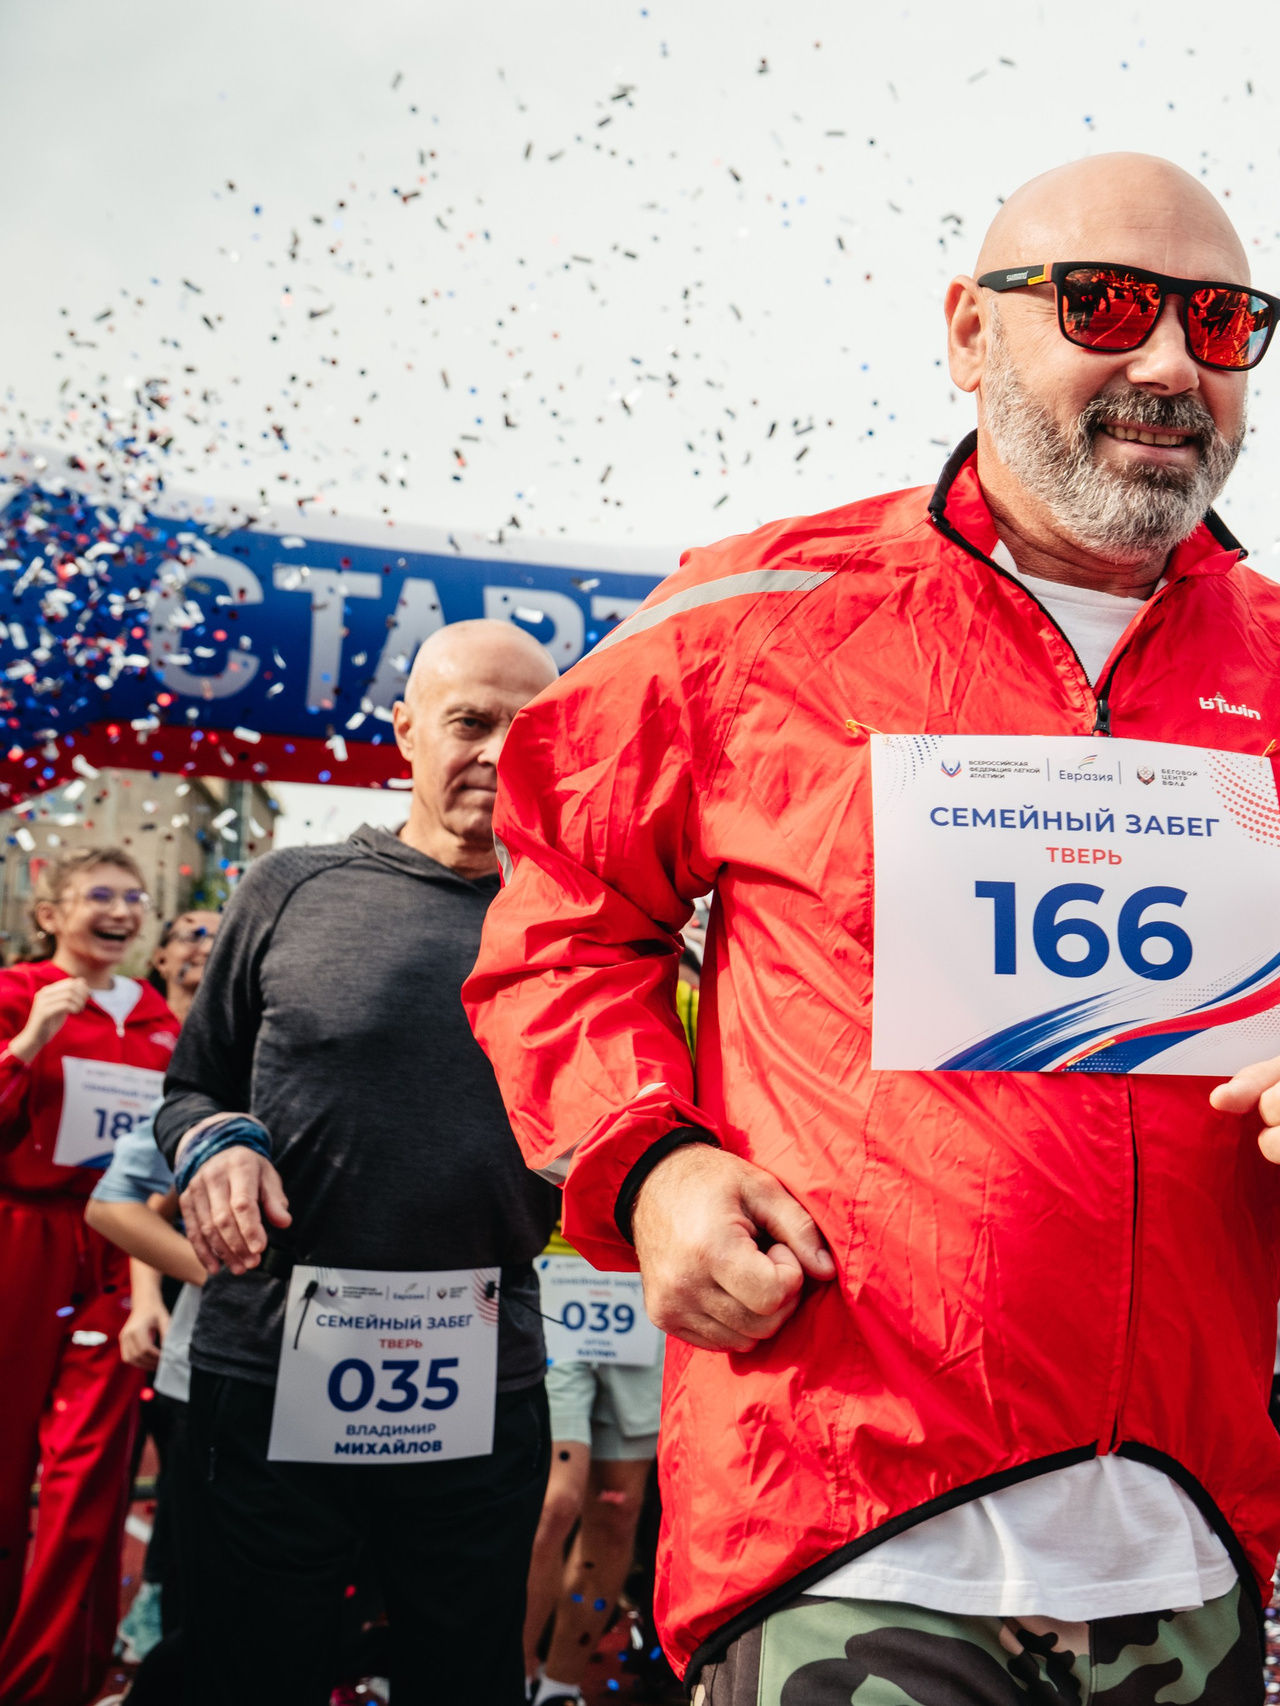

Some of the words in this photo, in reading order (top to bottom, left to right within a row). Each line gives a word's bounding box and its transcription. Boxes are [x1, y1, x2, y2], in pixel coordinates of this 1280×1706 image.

[150, 552, 644, 712] СТАР
[1059, 769, 1114, 783] Евразия
[1161, 768, 1198, 777] БЕГОВОЙ
[929, 804, 1115, 833] СЕМЕЙНЫЙ
[1125, 813, 1220, 837] ЗАБЕГ
[1045, 847, 1123, 865] ТВЕРЬ
[974, 880, 1194, 981] 166
[94, 1108, 151, 1140] 18
[316, 1314, 422, 1331] СЕМЕЙНЫЙ
[426, 1314, 474, 1330] ЗАБЕГ
[562, 1301, 635, 1334] 039
[378, 1338, 423, 1349] ТВЕРЬ
[327, 1357, 460, 1413] 035
[345, 1423, 437, 1438] ВЛАДИМИР
[334, 1438, 443, 1456] МИХАЙЛОВ
